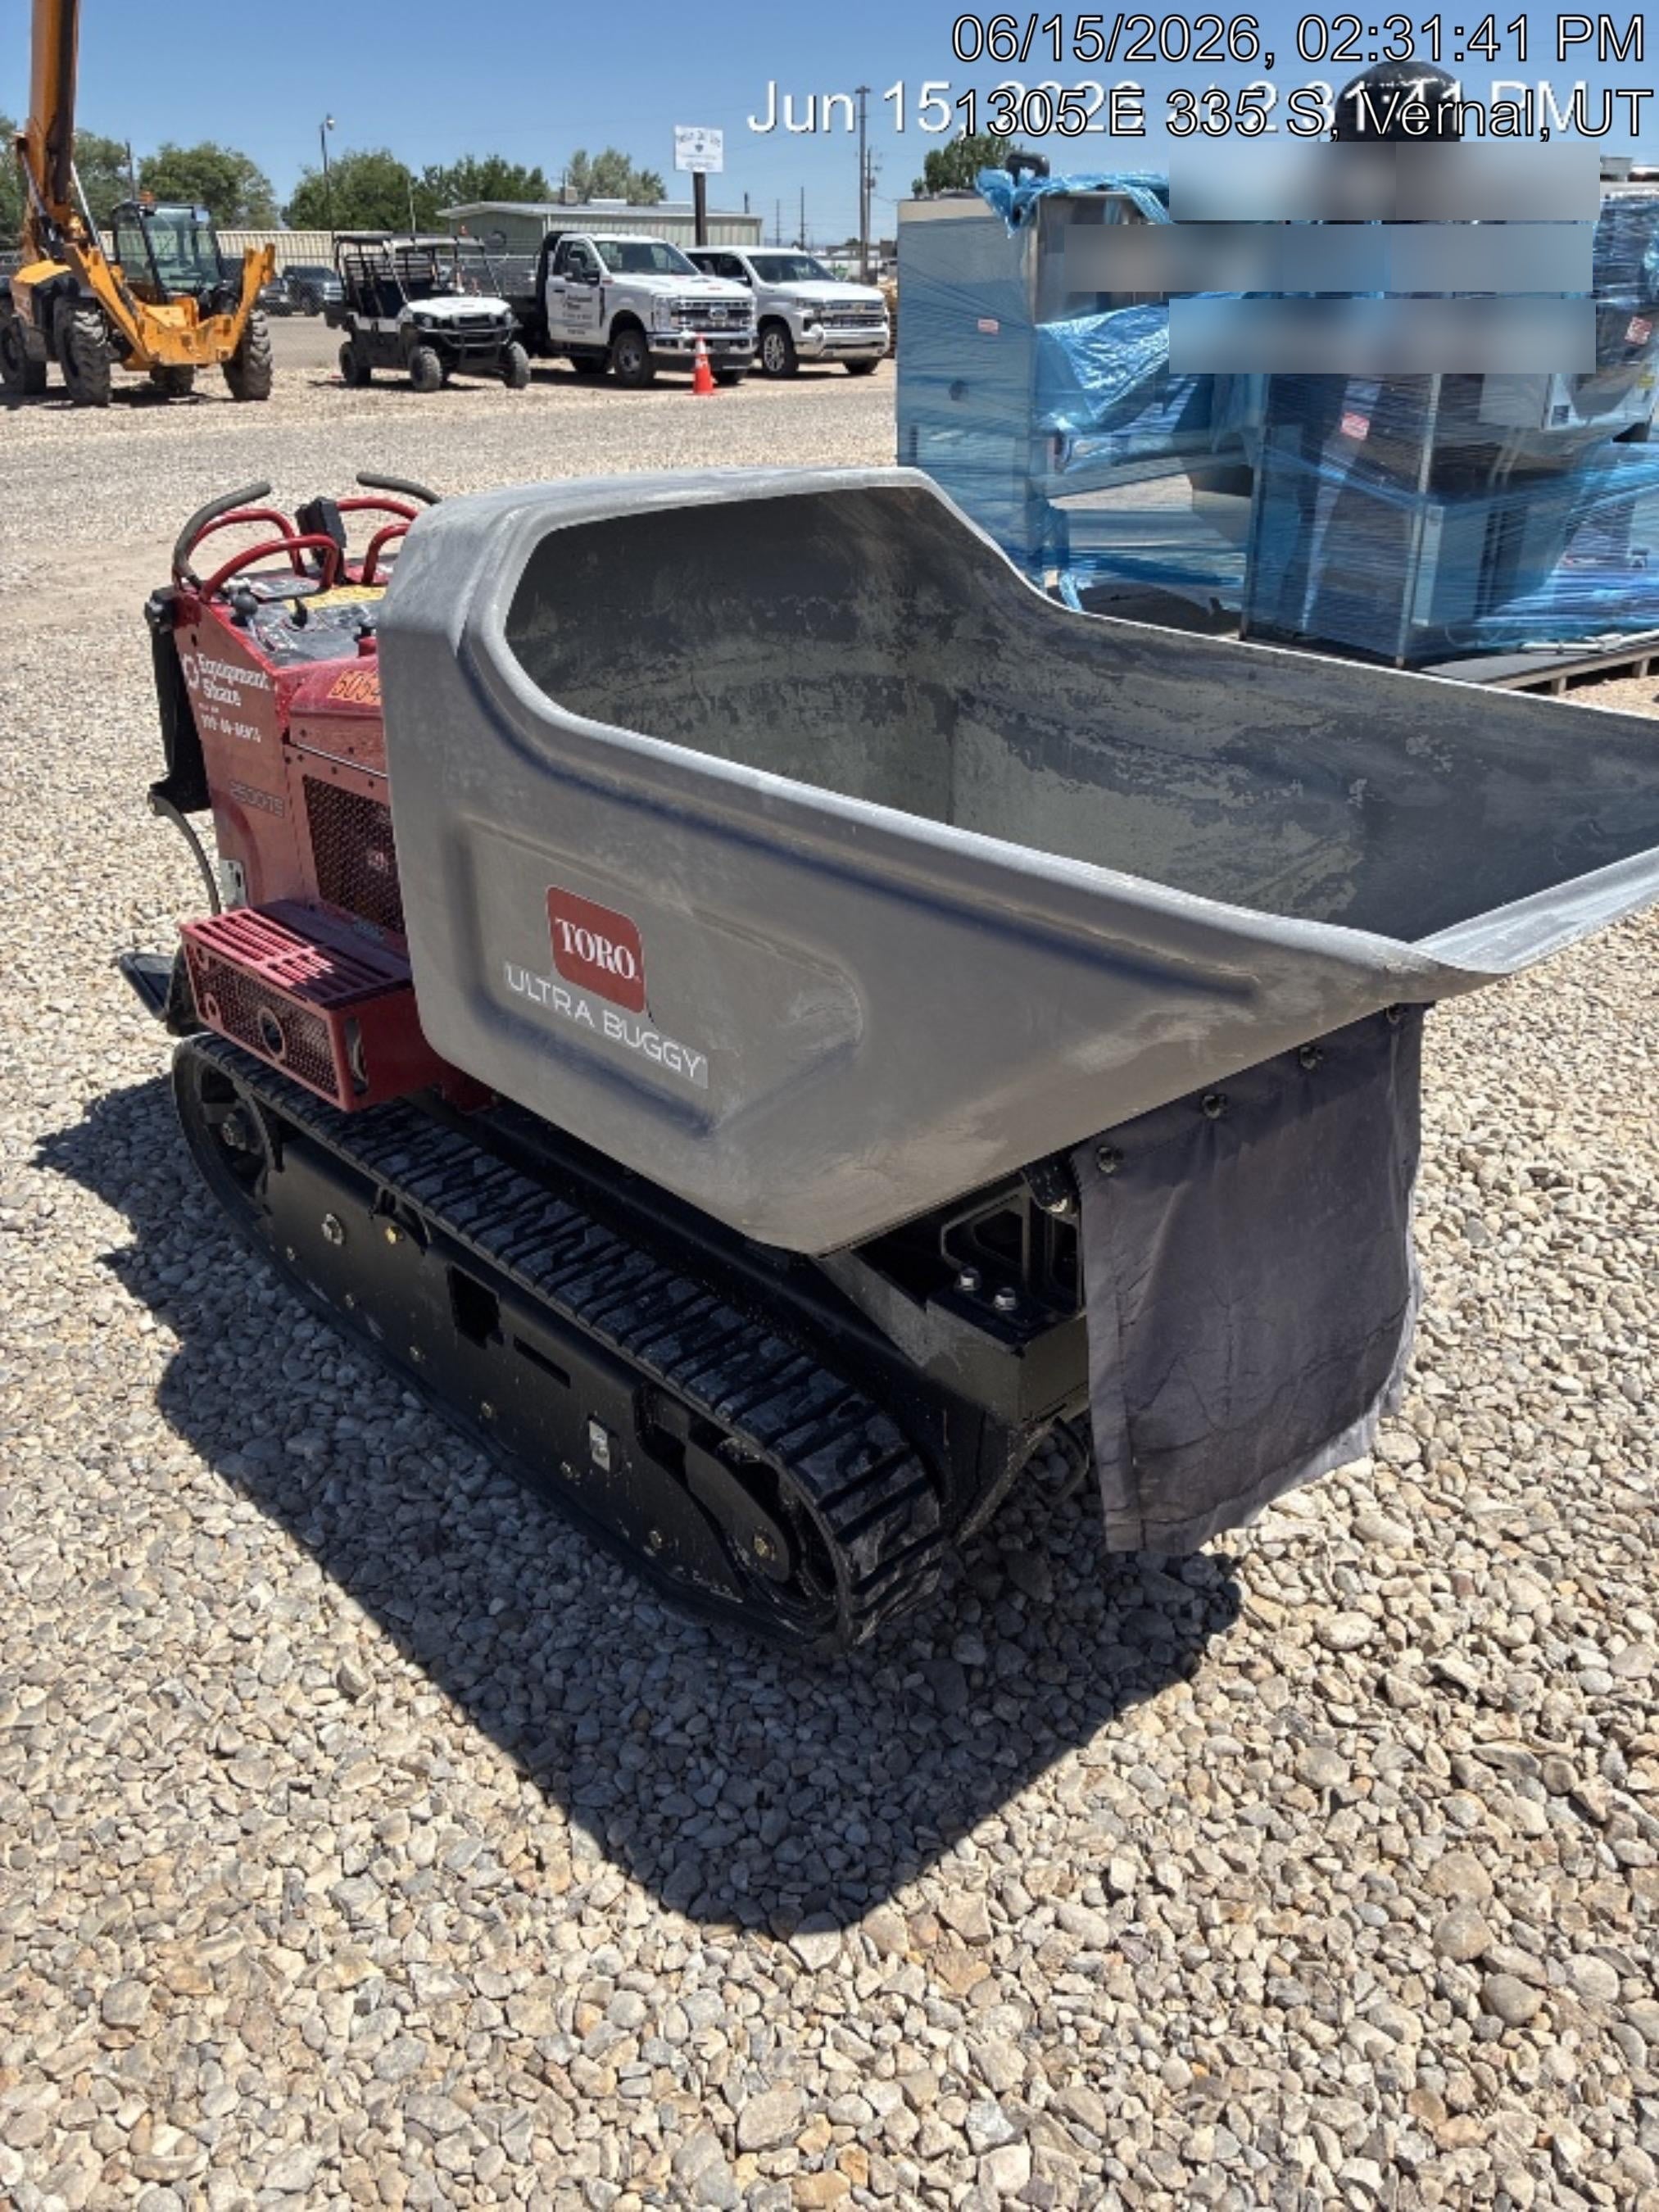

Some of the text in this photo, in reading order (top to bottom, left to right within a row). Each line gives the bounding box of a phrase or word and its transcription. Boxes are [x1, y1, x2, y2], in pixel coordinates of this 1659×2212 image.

[555, 918, 636, 980] TORO
[505, 962, 701, 1079] ULTRA BUGGY
